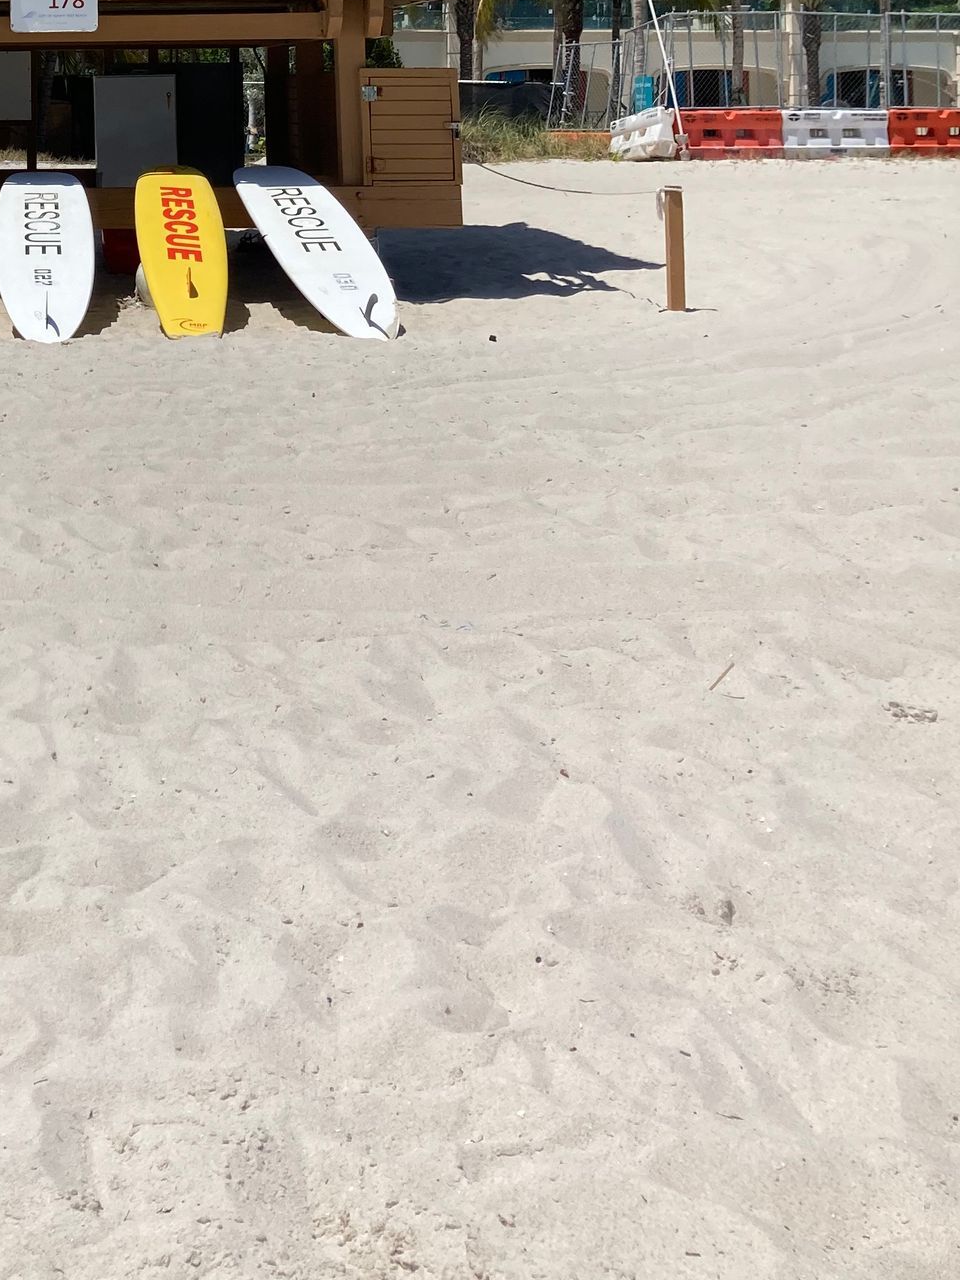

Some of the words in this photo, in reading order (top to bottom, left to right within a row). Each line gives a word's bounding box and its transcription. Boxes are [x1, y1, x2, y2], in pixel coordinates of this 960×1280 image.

[24, 192, 62, 255] RESCUE
[159, 186, 204, 263] RESCUE
[266, 187, 342, 253] RESCUE
